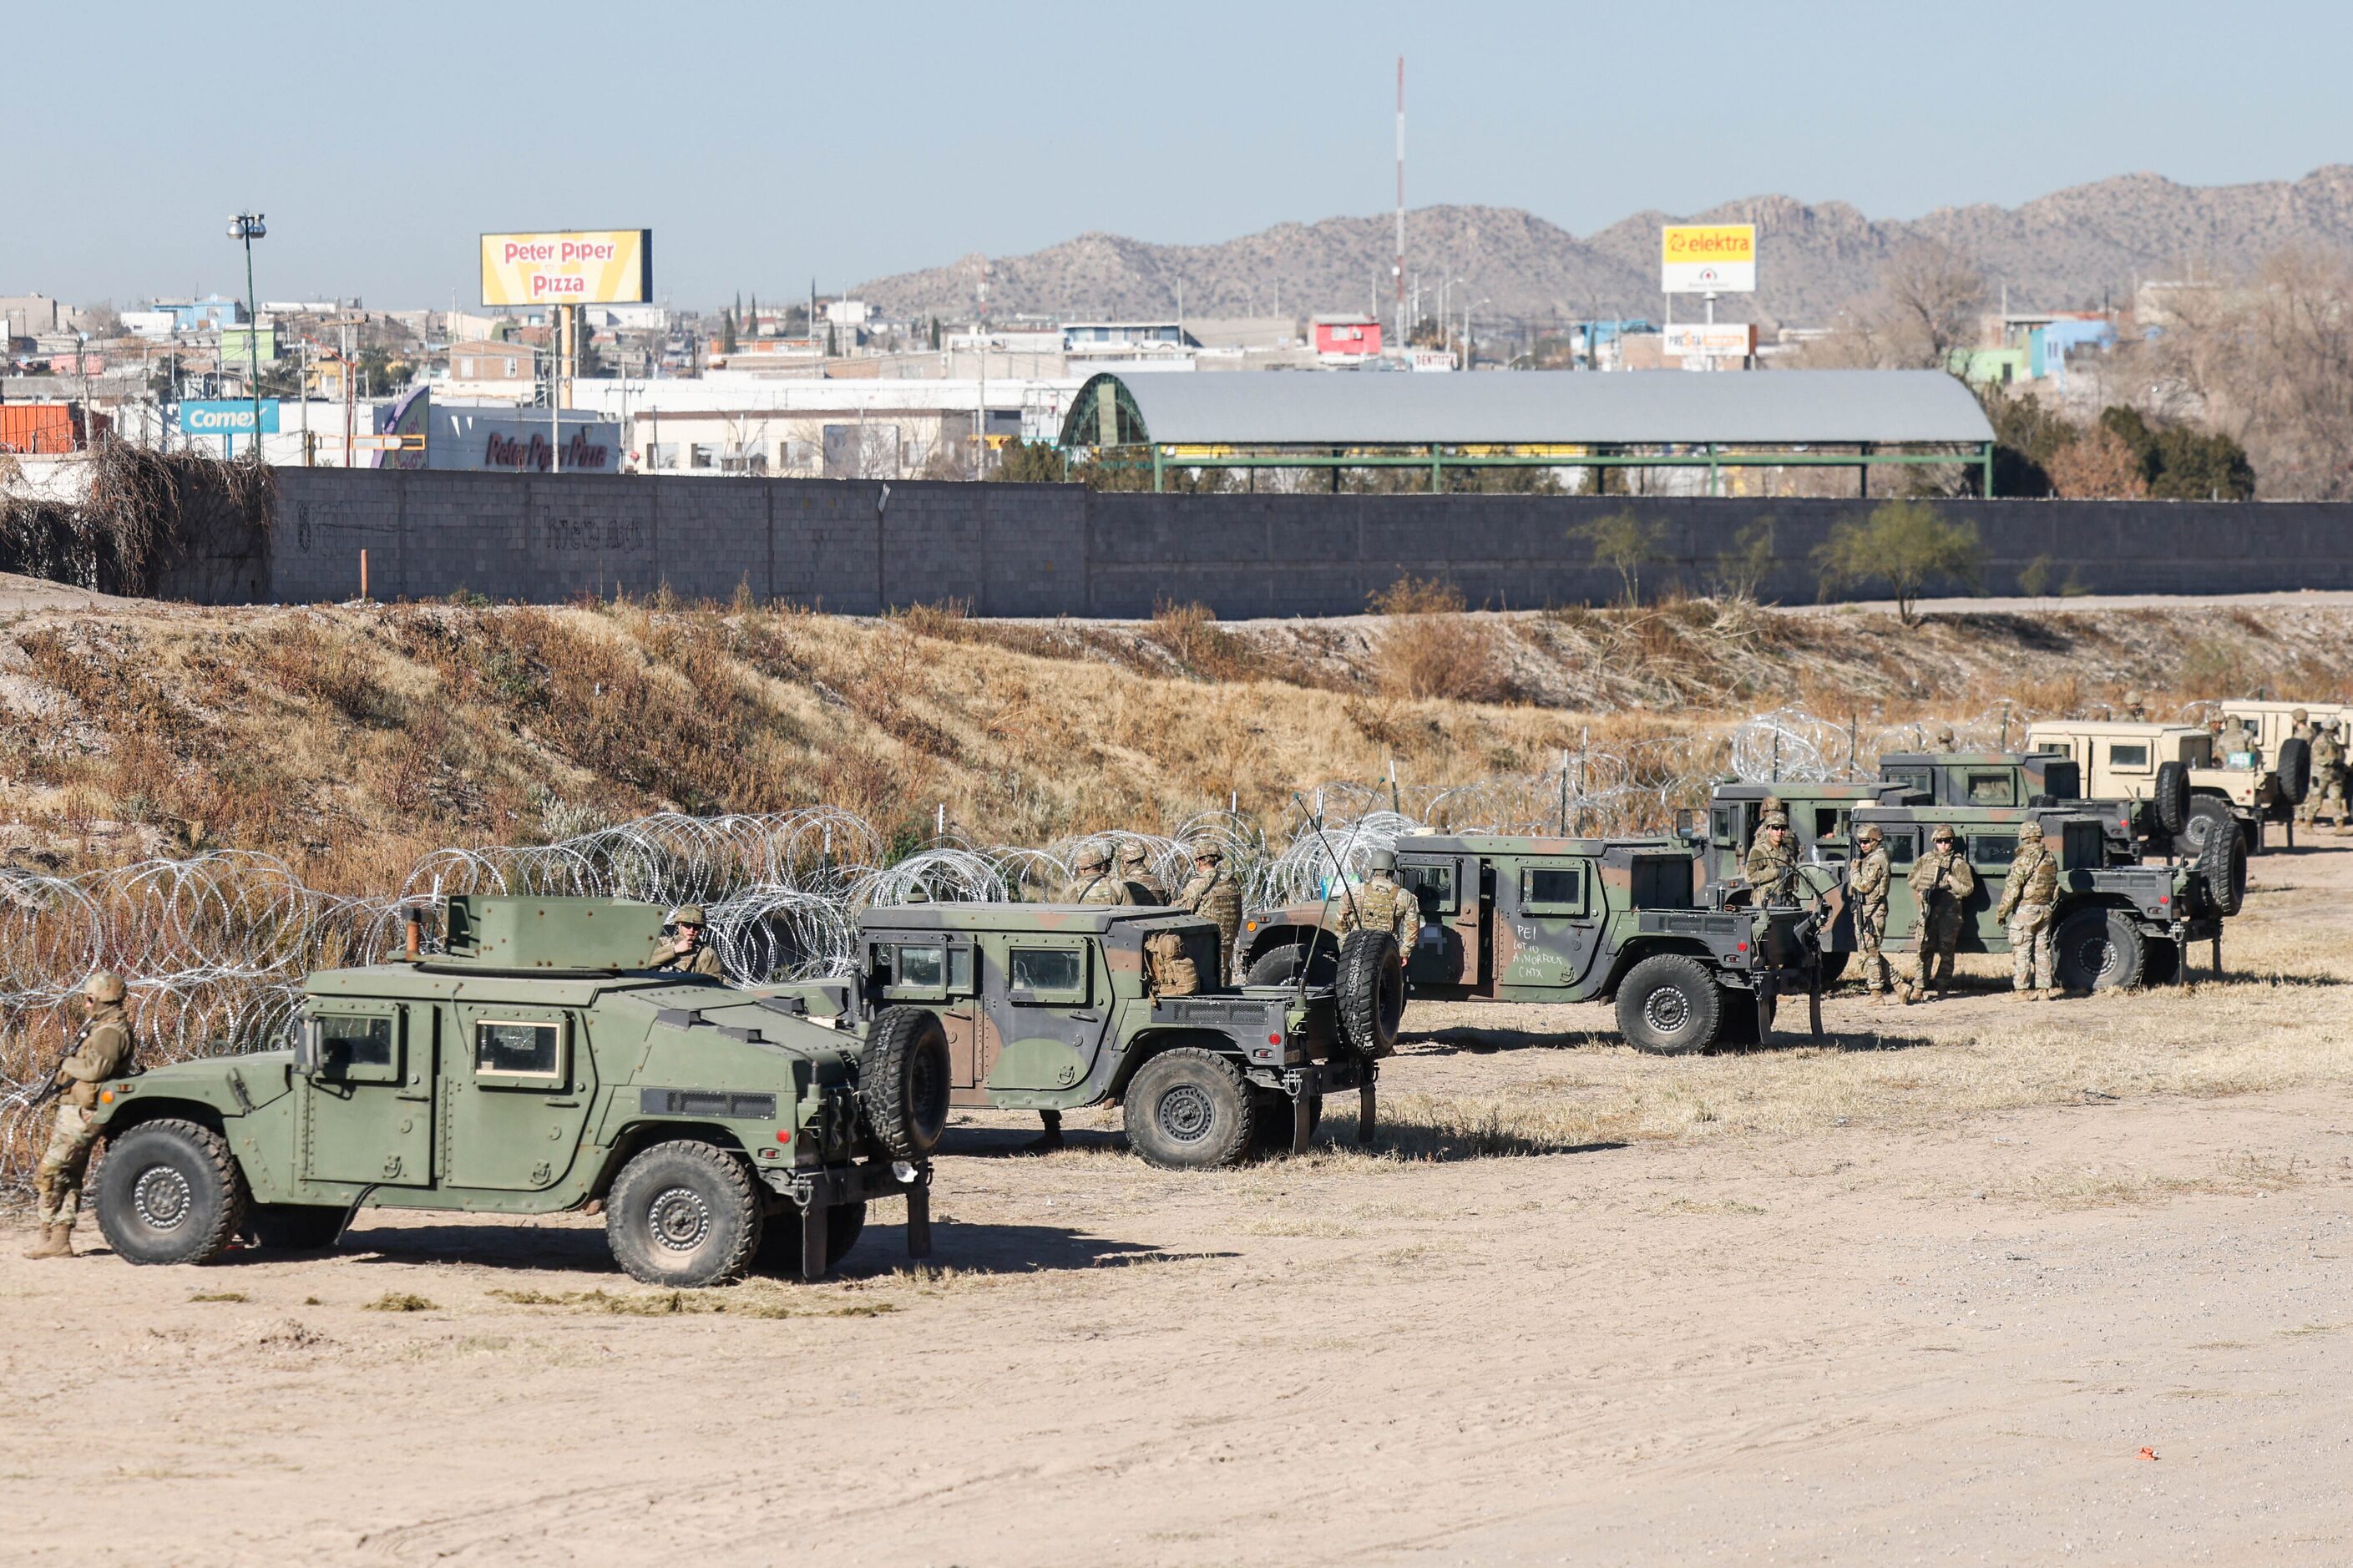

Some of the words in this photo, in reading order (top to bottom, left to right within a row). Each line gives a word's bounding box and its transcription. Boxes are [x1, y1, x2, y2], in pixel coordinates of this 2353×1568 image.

[504, 243, 555, 264] Peter
[561, 241, 615, 263] Piper
[1689, 233, 1749, 252] elektra
[533, 276, 584, 296] Pizza
[190, 407, 268, 428] Comex
